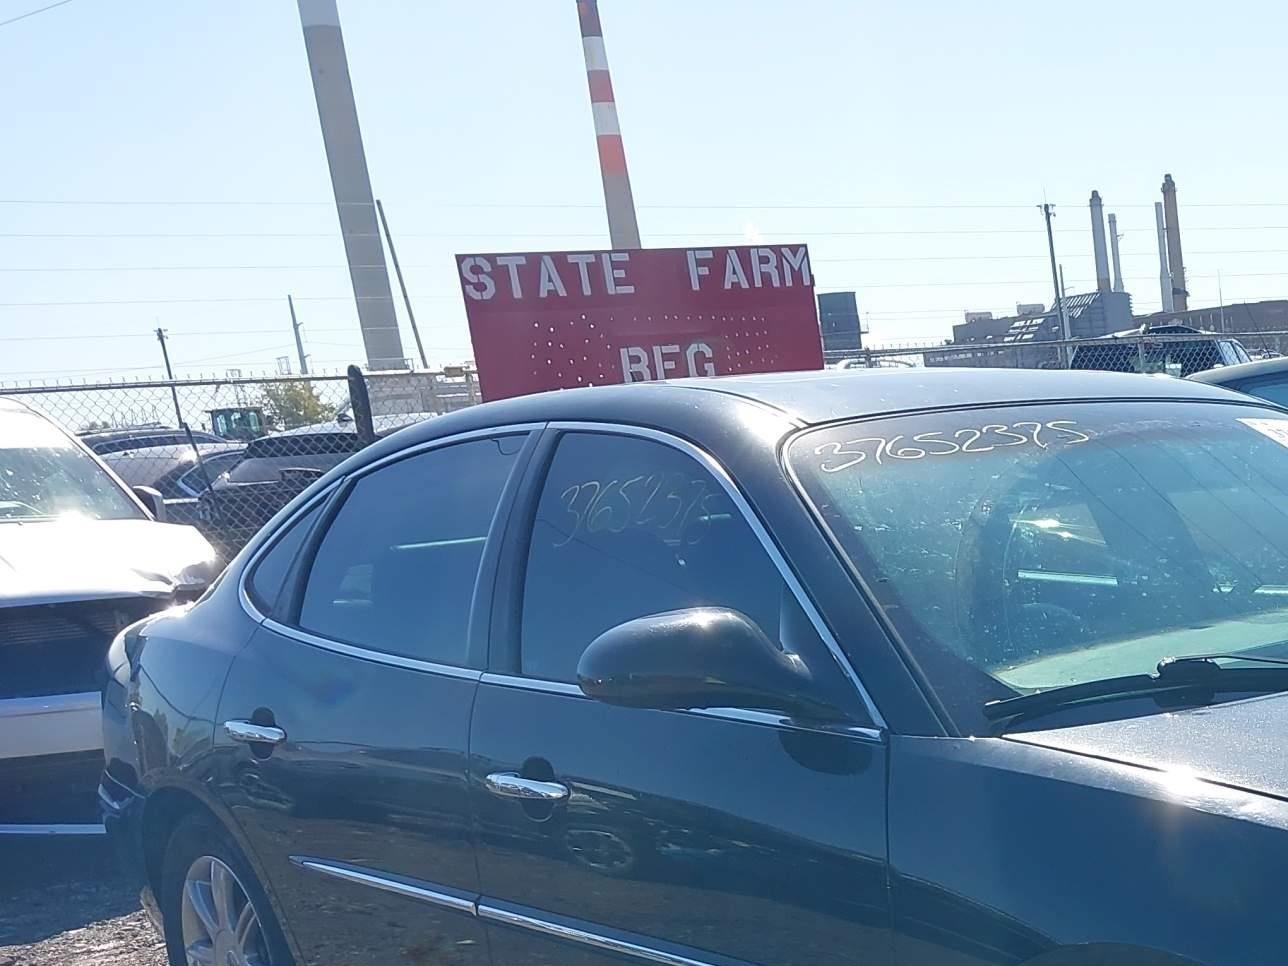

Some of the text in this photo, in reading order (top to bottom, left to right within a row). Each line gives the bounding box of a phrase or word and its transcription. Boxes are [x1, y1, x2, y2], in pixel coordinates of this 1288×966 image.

[461, 246, 811, 300] STATE FARM
[814, 421, 1090, 473] 37652375
